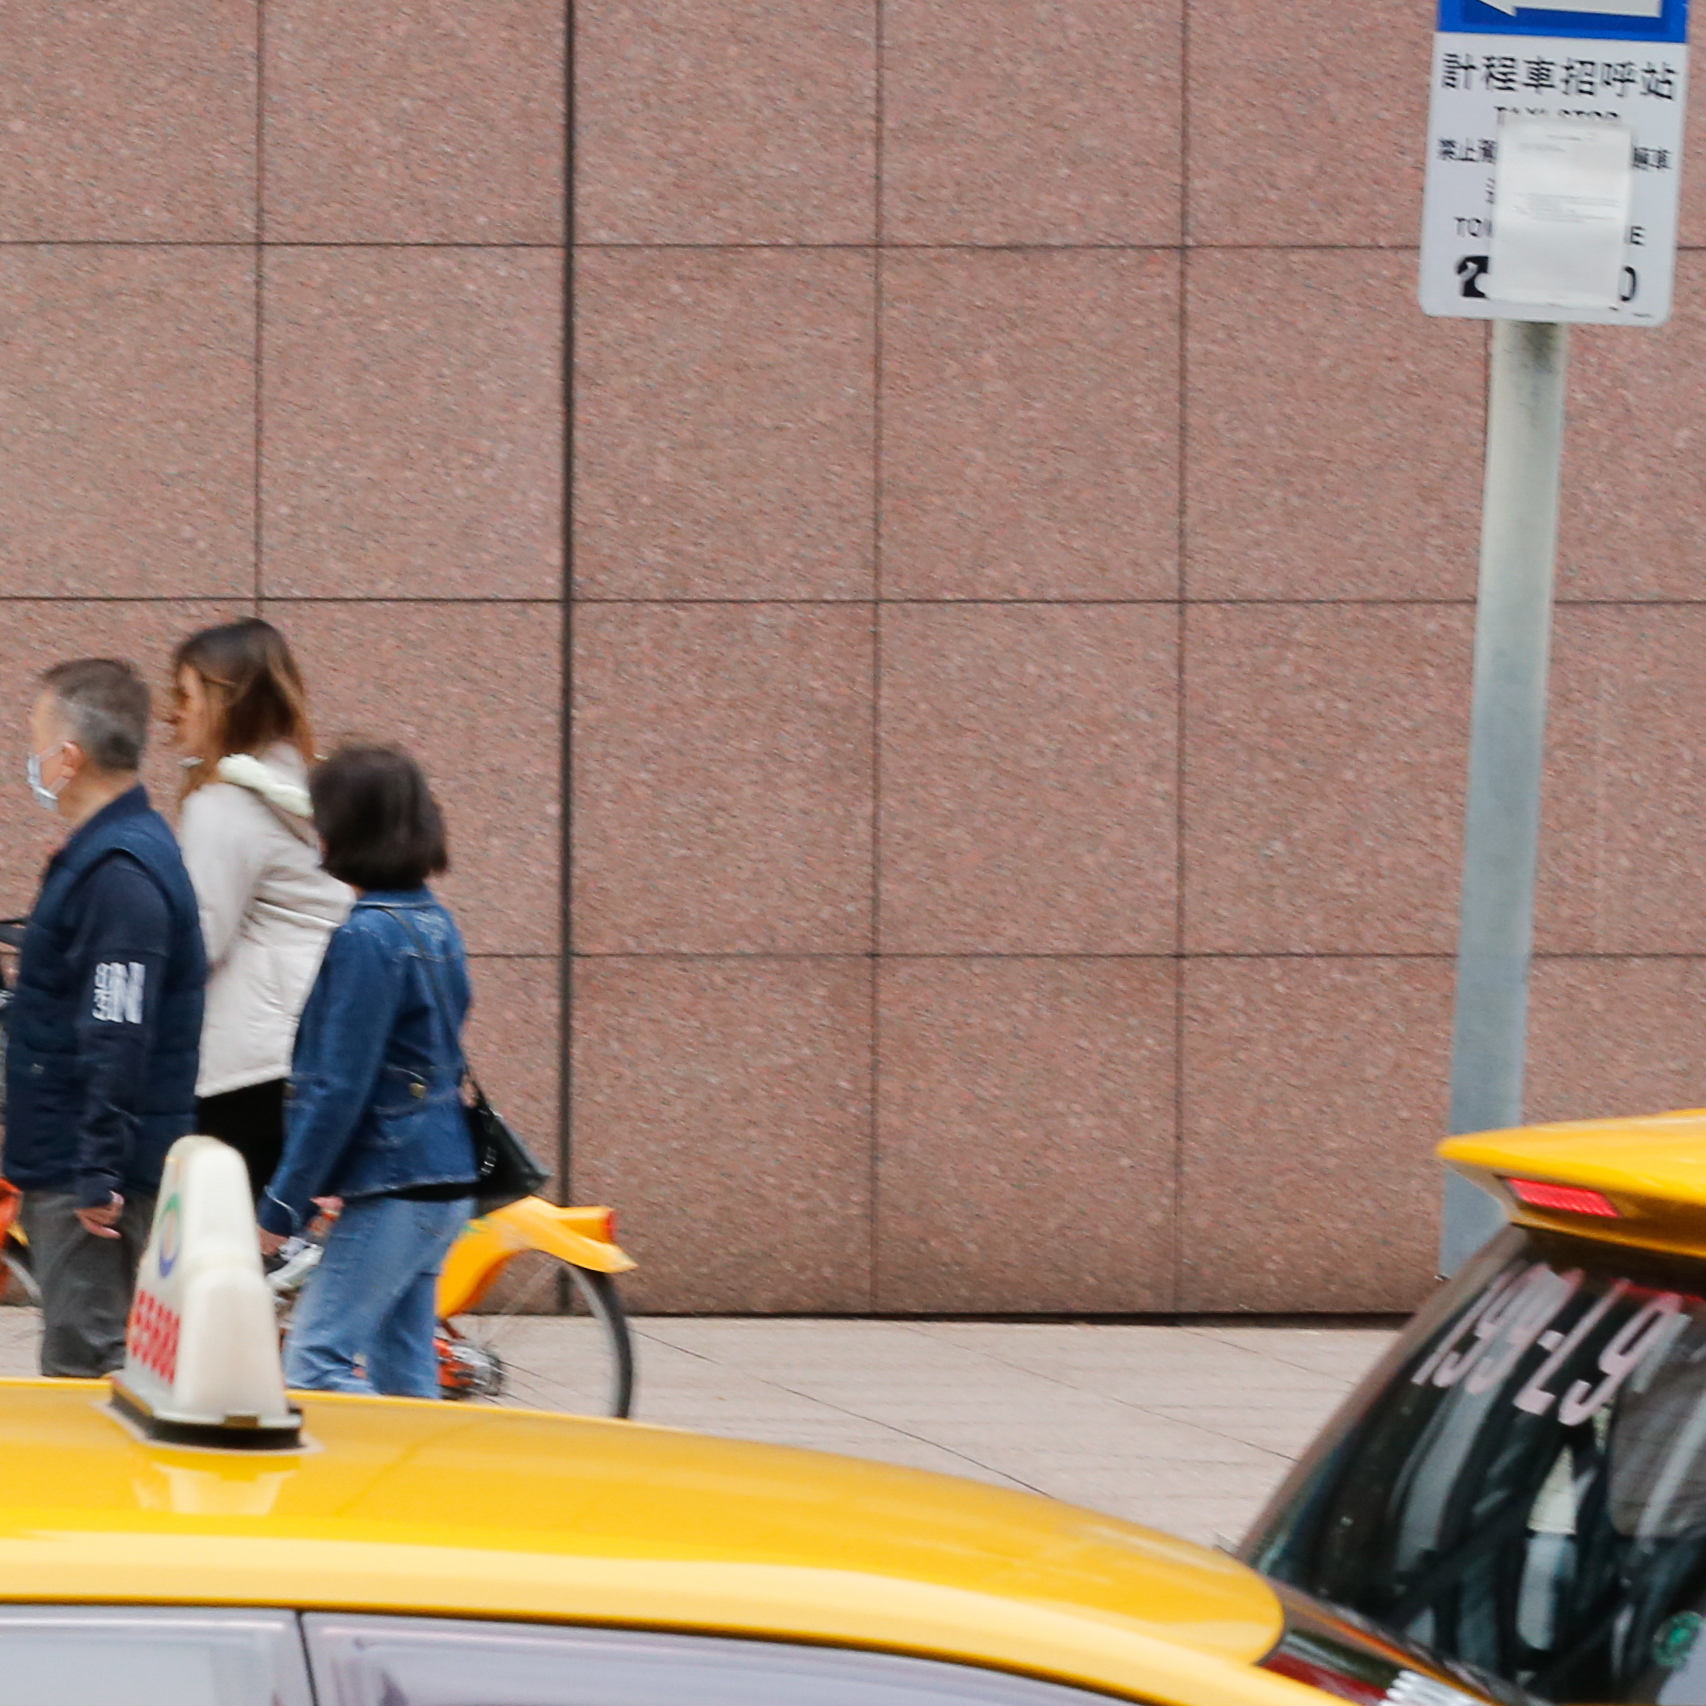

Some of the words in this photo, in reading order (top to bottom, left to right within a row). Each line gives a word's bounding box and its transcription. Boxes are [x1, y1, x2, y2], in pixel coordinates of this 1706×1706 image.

[1441, 53, 1678, 101] 計程車招呼站
